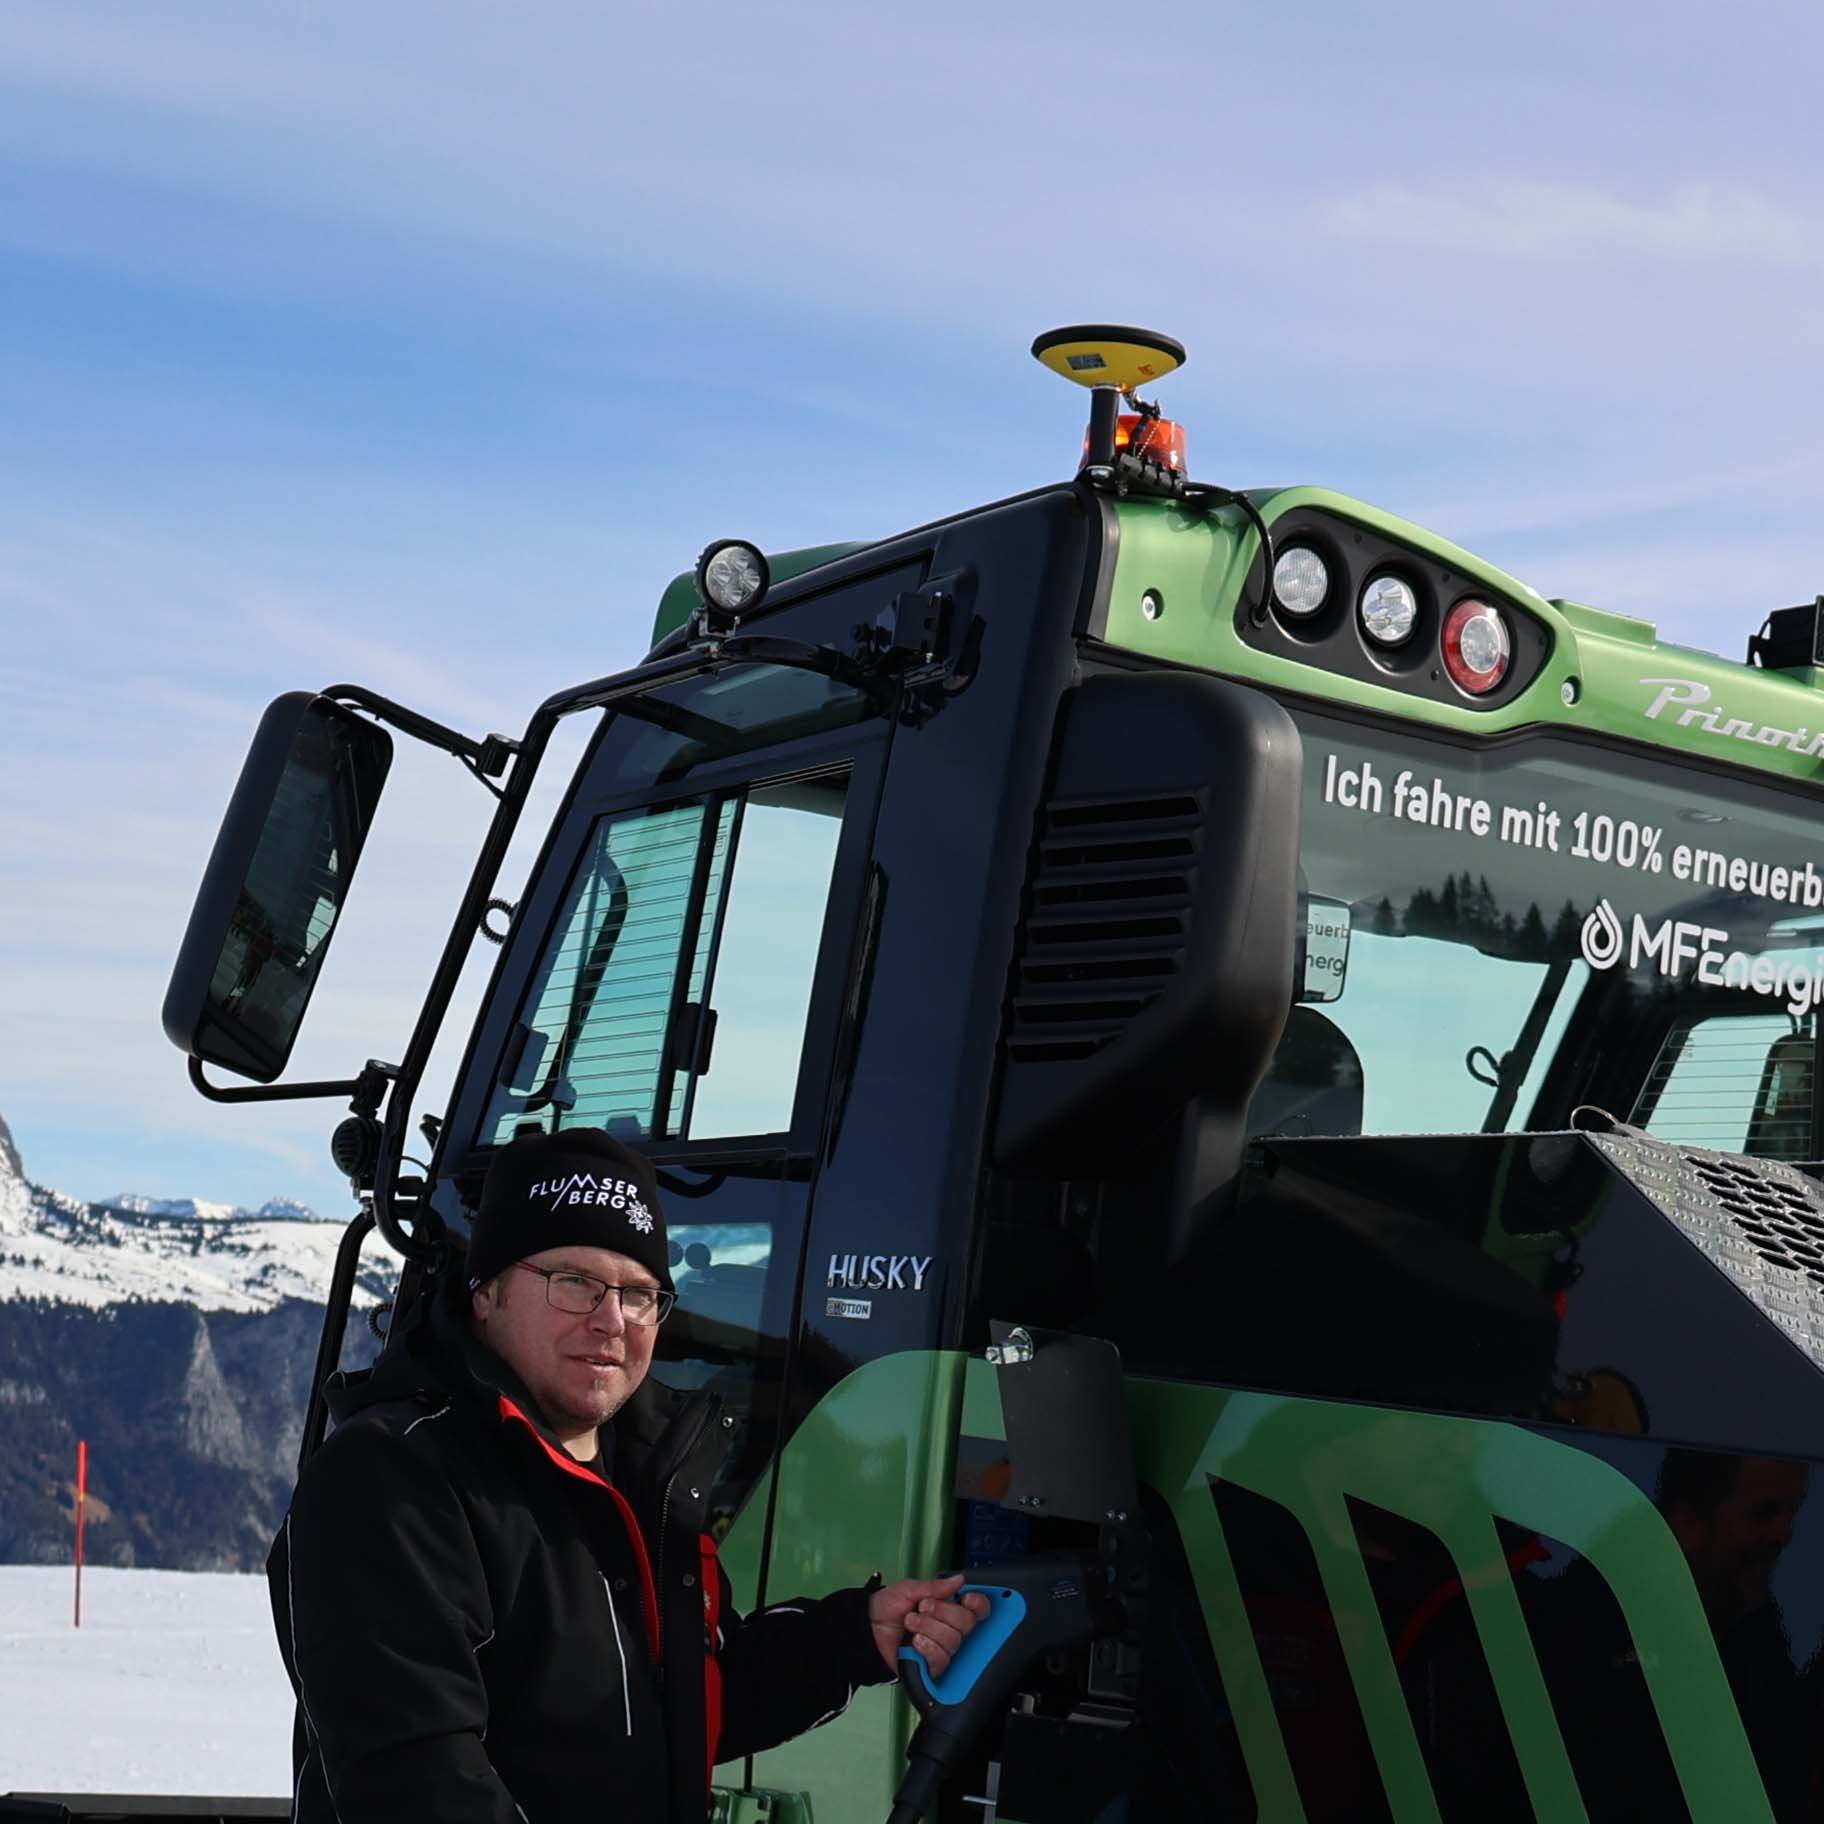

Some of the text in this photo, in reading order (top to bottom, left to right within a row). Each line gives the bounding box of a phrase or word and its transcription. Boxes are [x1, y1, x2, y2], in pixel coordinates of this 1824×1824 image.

[1324, 753, 1383, 814] Ich
[1393, 769, 1492, 837] fahre
[1500, 800, 1561, 852] mit
[1571, 810, 1664, 874] 100%
[529, 1173, 638, 1212] FLUMSER
[568, 1190, 626, 1209] BERG
[826, 1254, 933, 1290] HUSKY
